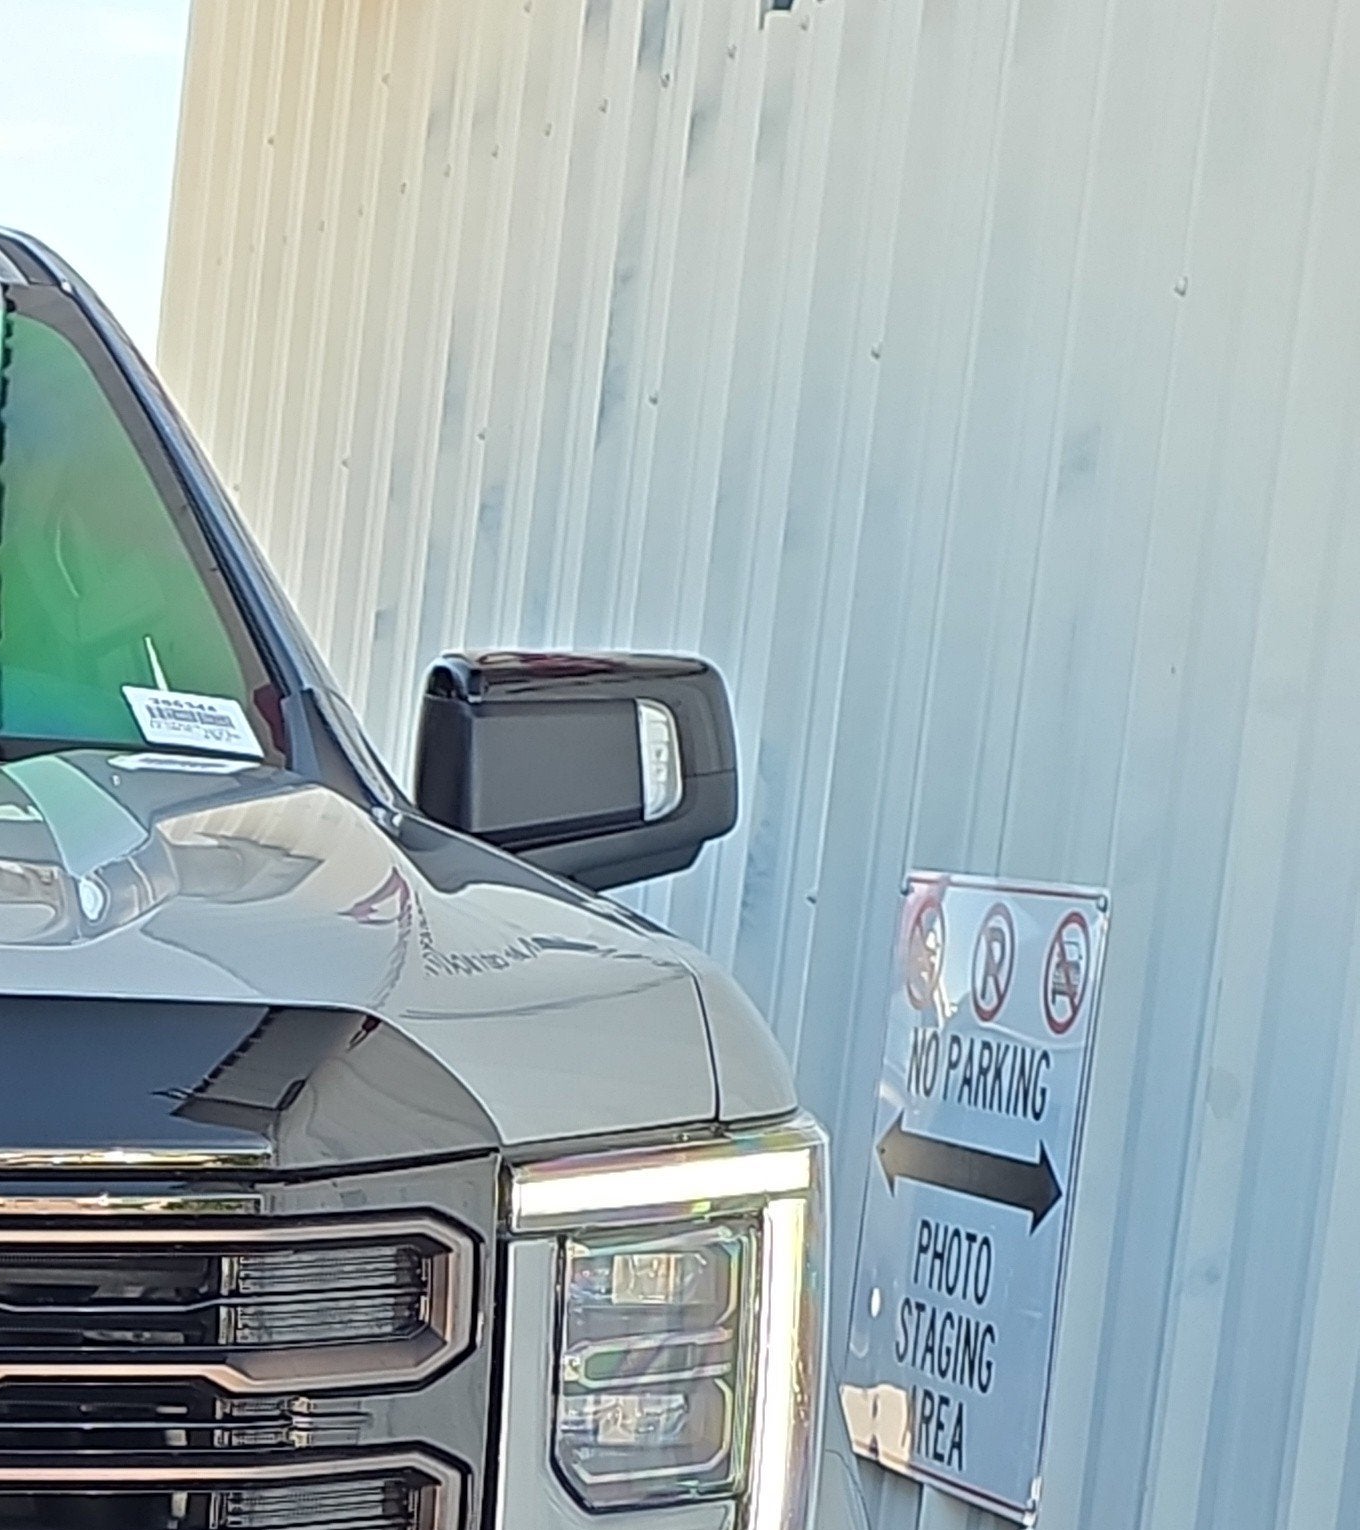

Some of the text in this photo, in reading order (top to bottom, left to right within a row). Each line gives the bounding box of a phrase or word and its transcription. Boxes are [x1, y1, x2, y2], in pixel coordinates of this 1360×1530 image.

[907, 1026, 1051, 1122] NO PARKING
[913, 1218, 992, 1306] PHOTO
[895, 1296, 996, 1394] STAGING
